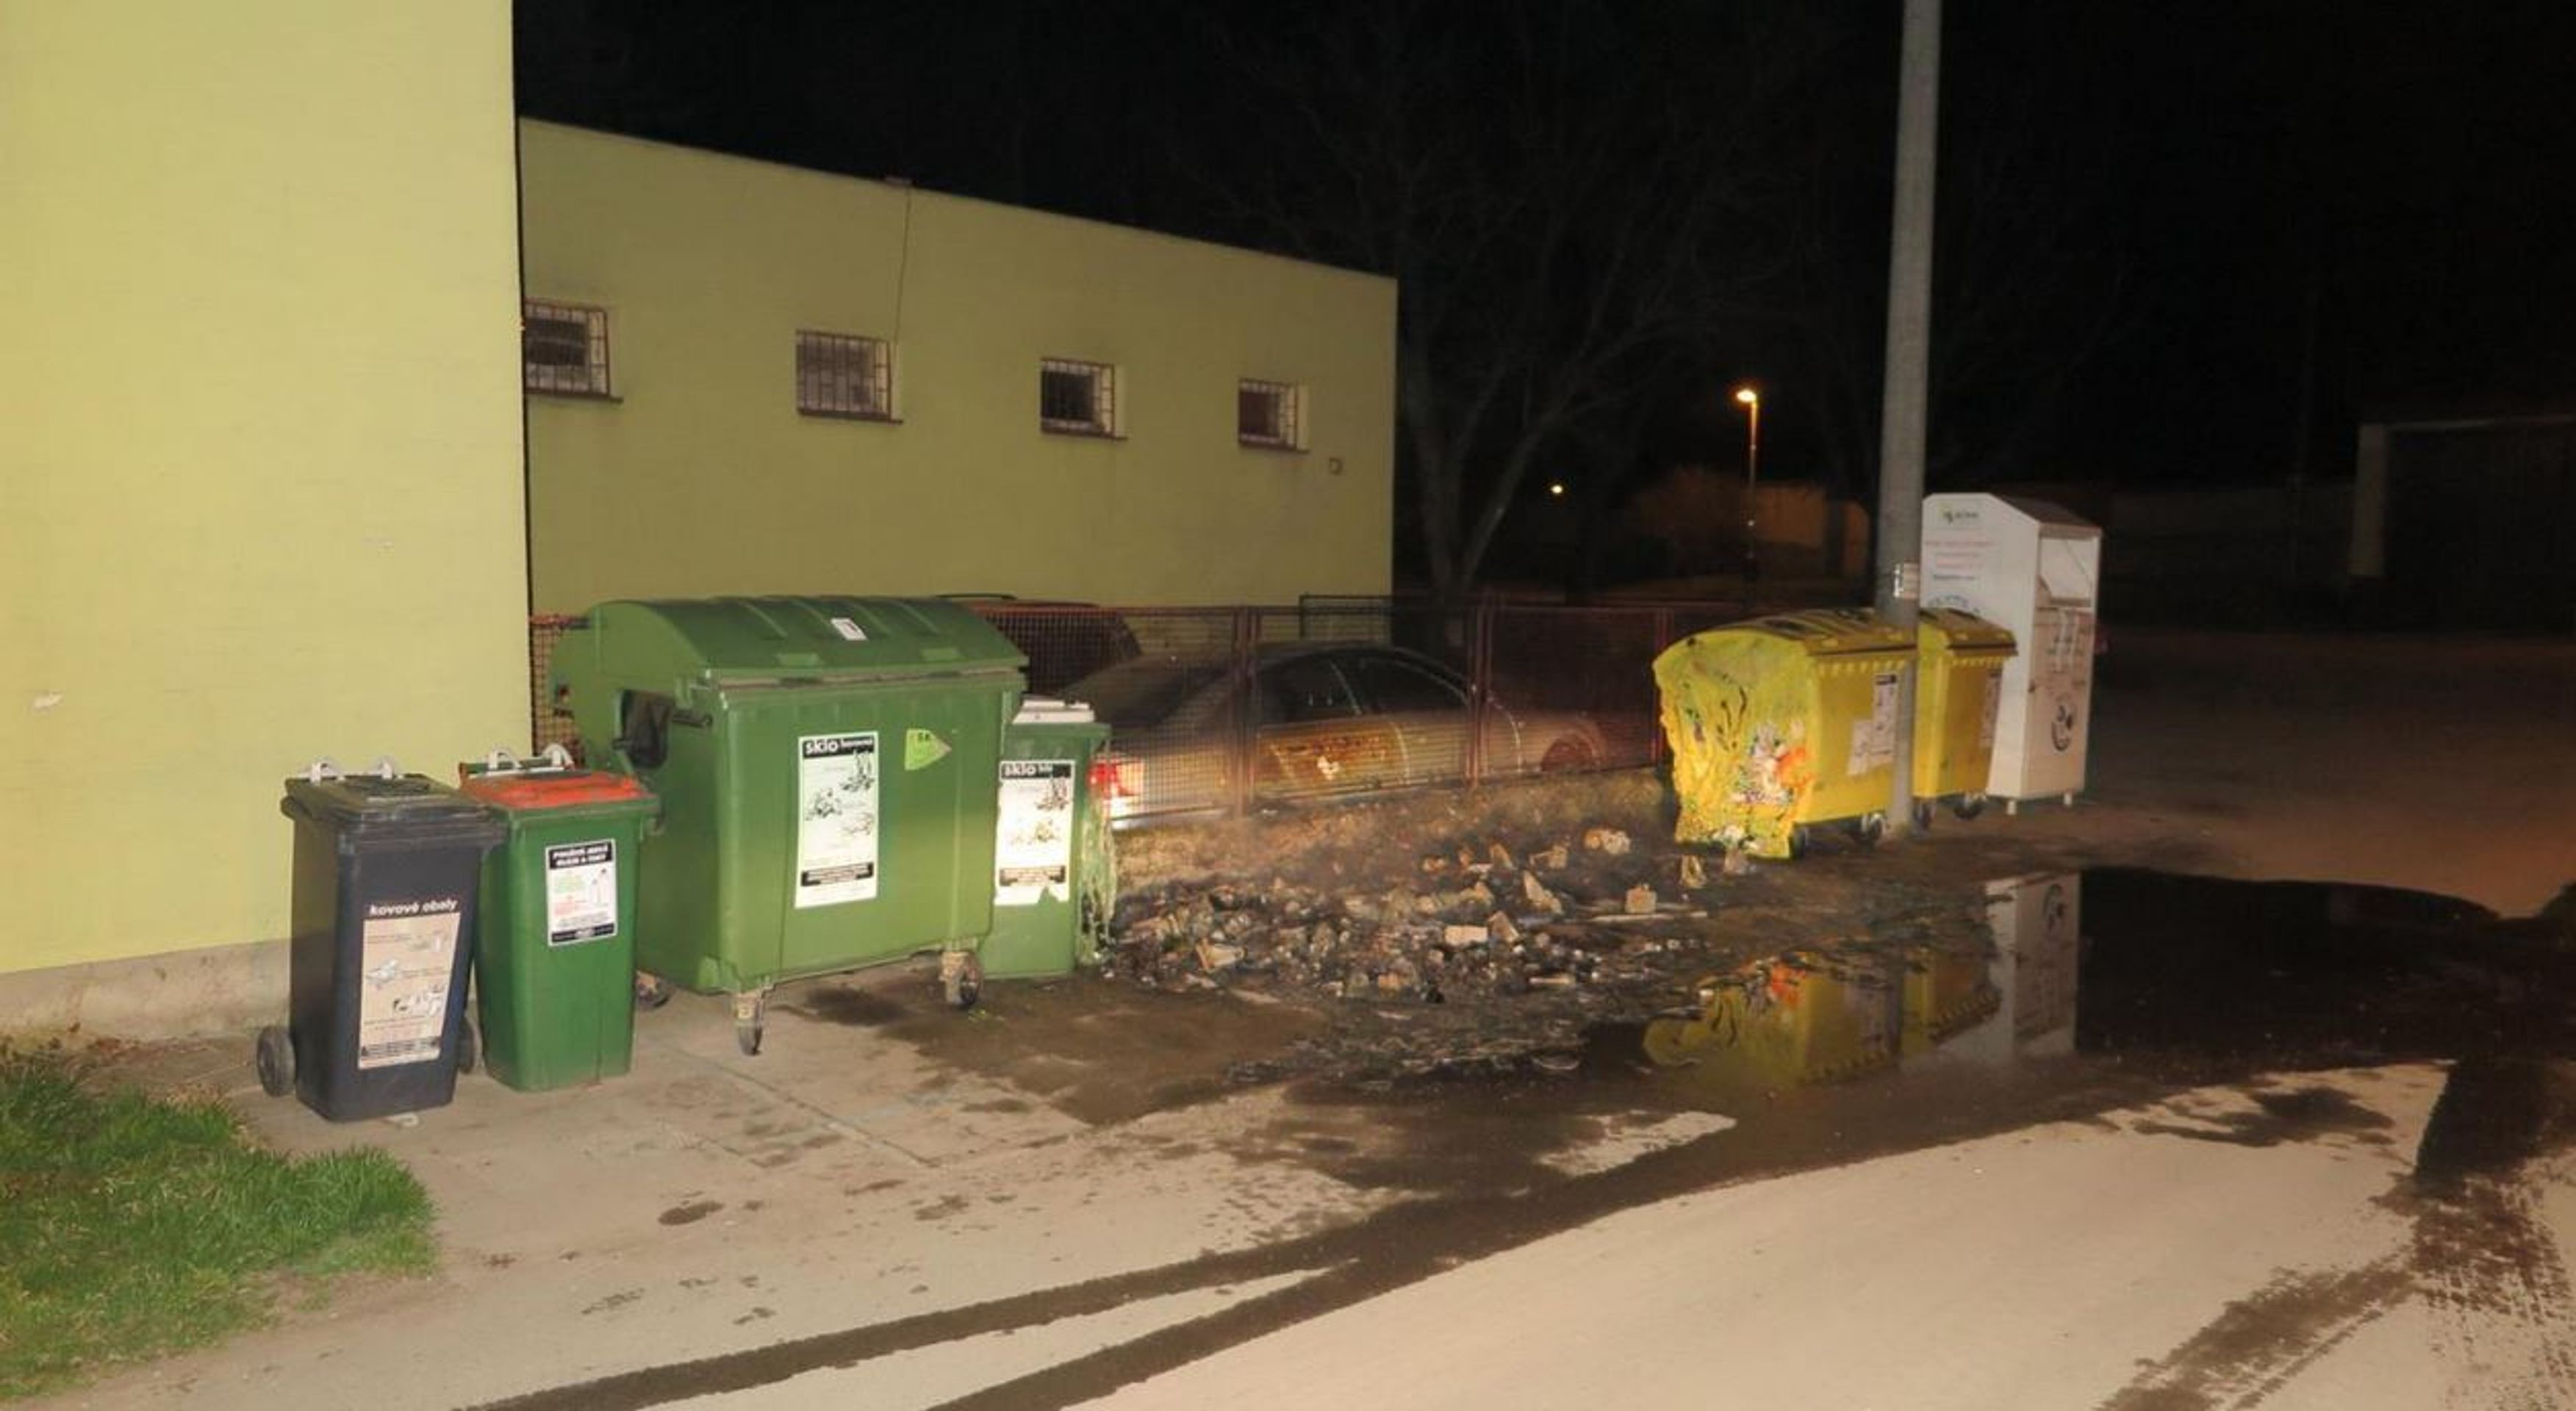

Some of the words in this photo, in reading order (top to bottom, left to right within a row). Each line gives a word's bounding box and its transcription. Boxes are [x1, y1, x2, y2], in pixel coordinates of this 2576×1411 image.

[806, 739, 839, 755] sklo
[1005, 763, 1037, 777] sklo
[370, 902, 420, 916] kovové
[423, 898, 458, 911] obaly
